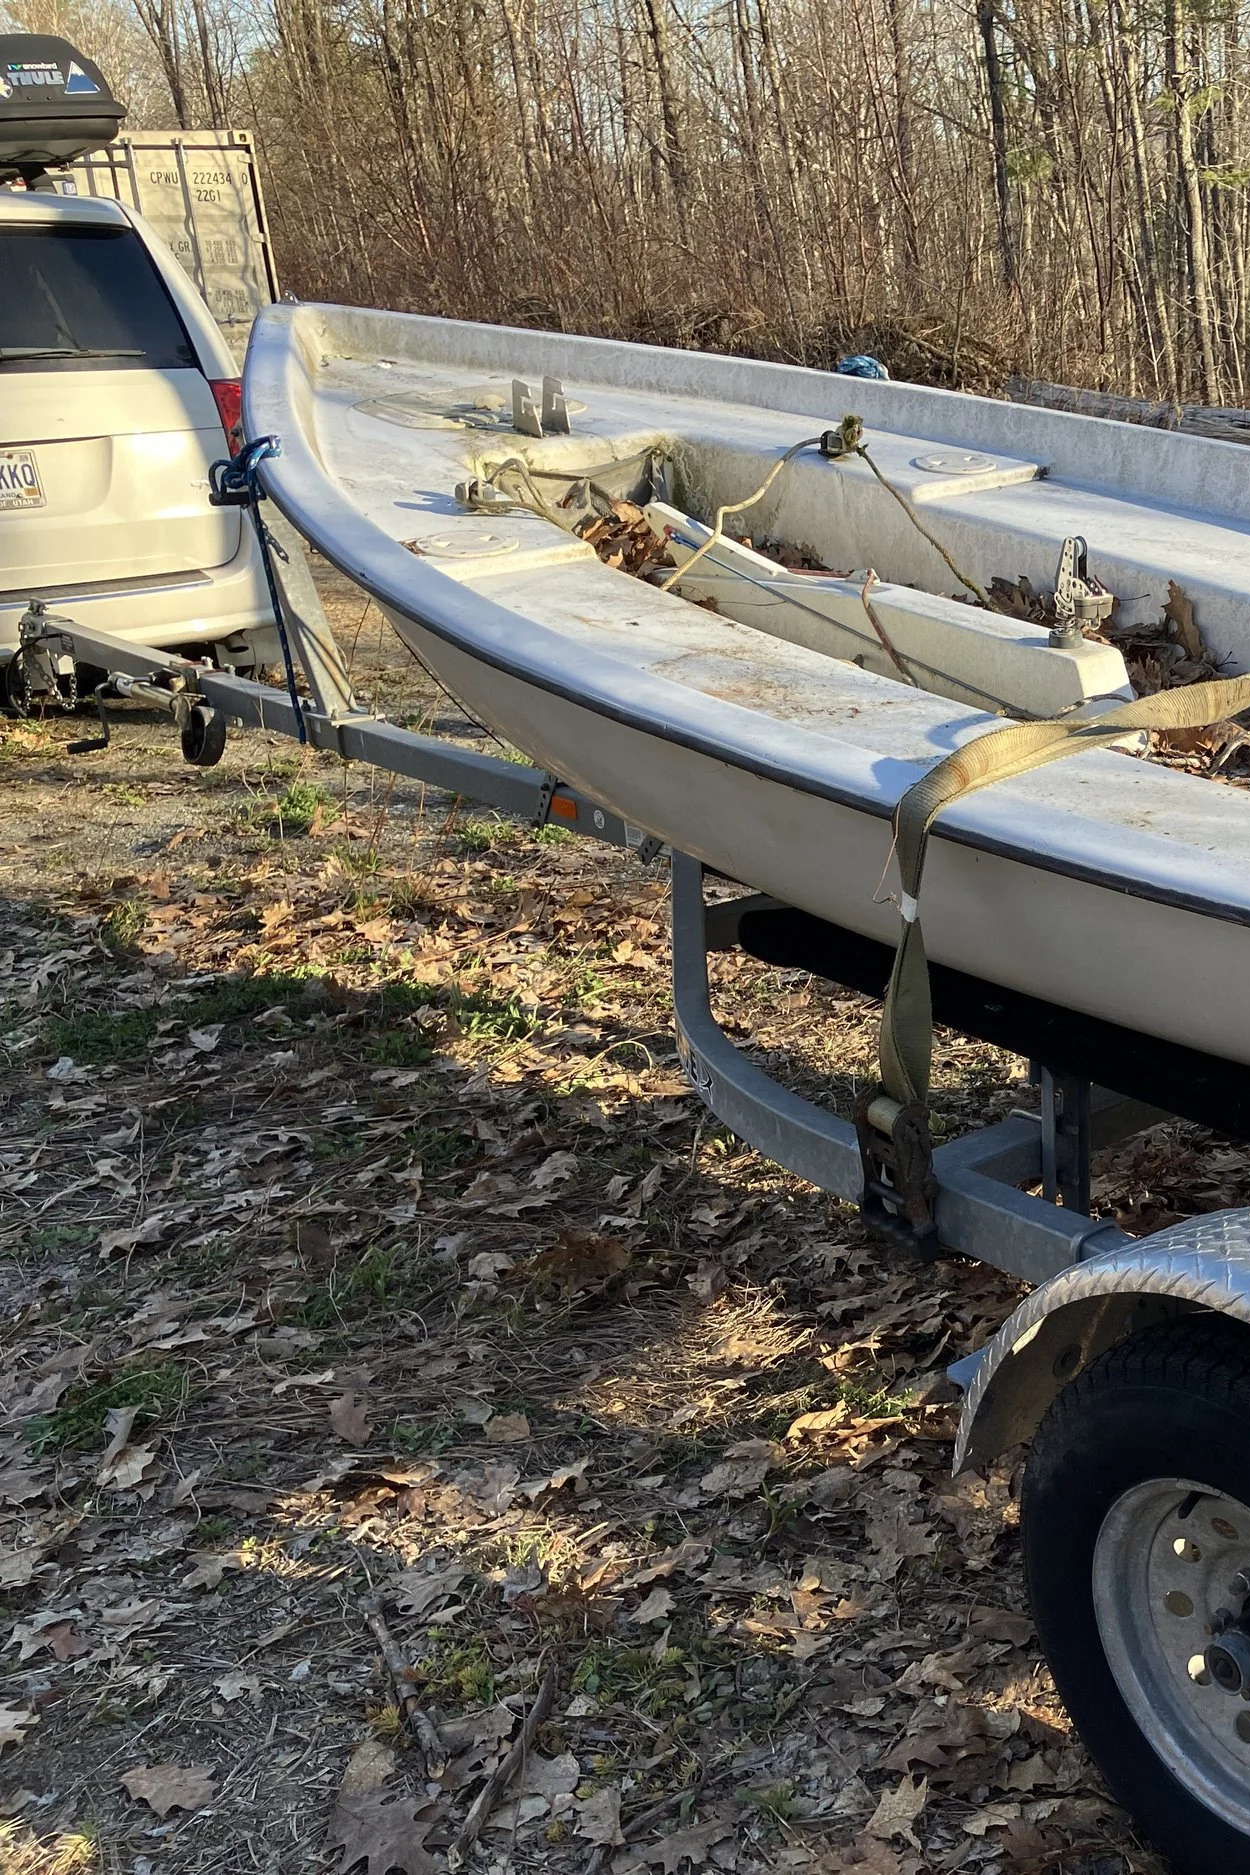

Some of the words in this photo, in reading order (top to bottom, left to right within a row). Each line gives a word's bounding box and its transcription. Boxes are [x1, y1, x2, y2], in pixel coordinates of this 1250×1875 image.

[7, 71, 64, 86] THULE
[150, 171, 179, 184] CPWU
[192, 172, 232, 184] 222434
[196, 189, 222, 202] 22G1
[12, 498, 34, 506] UTAH
